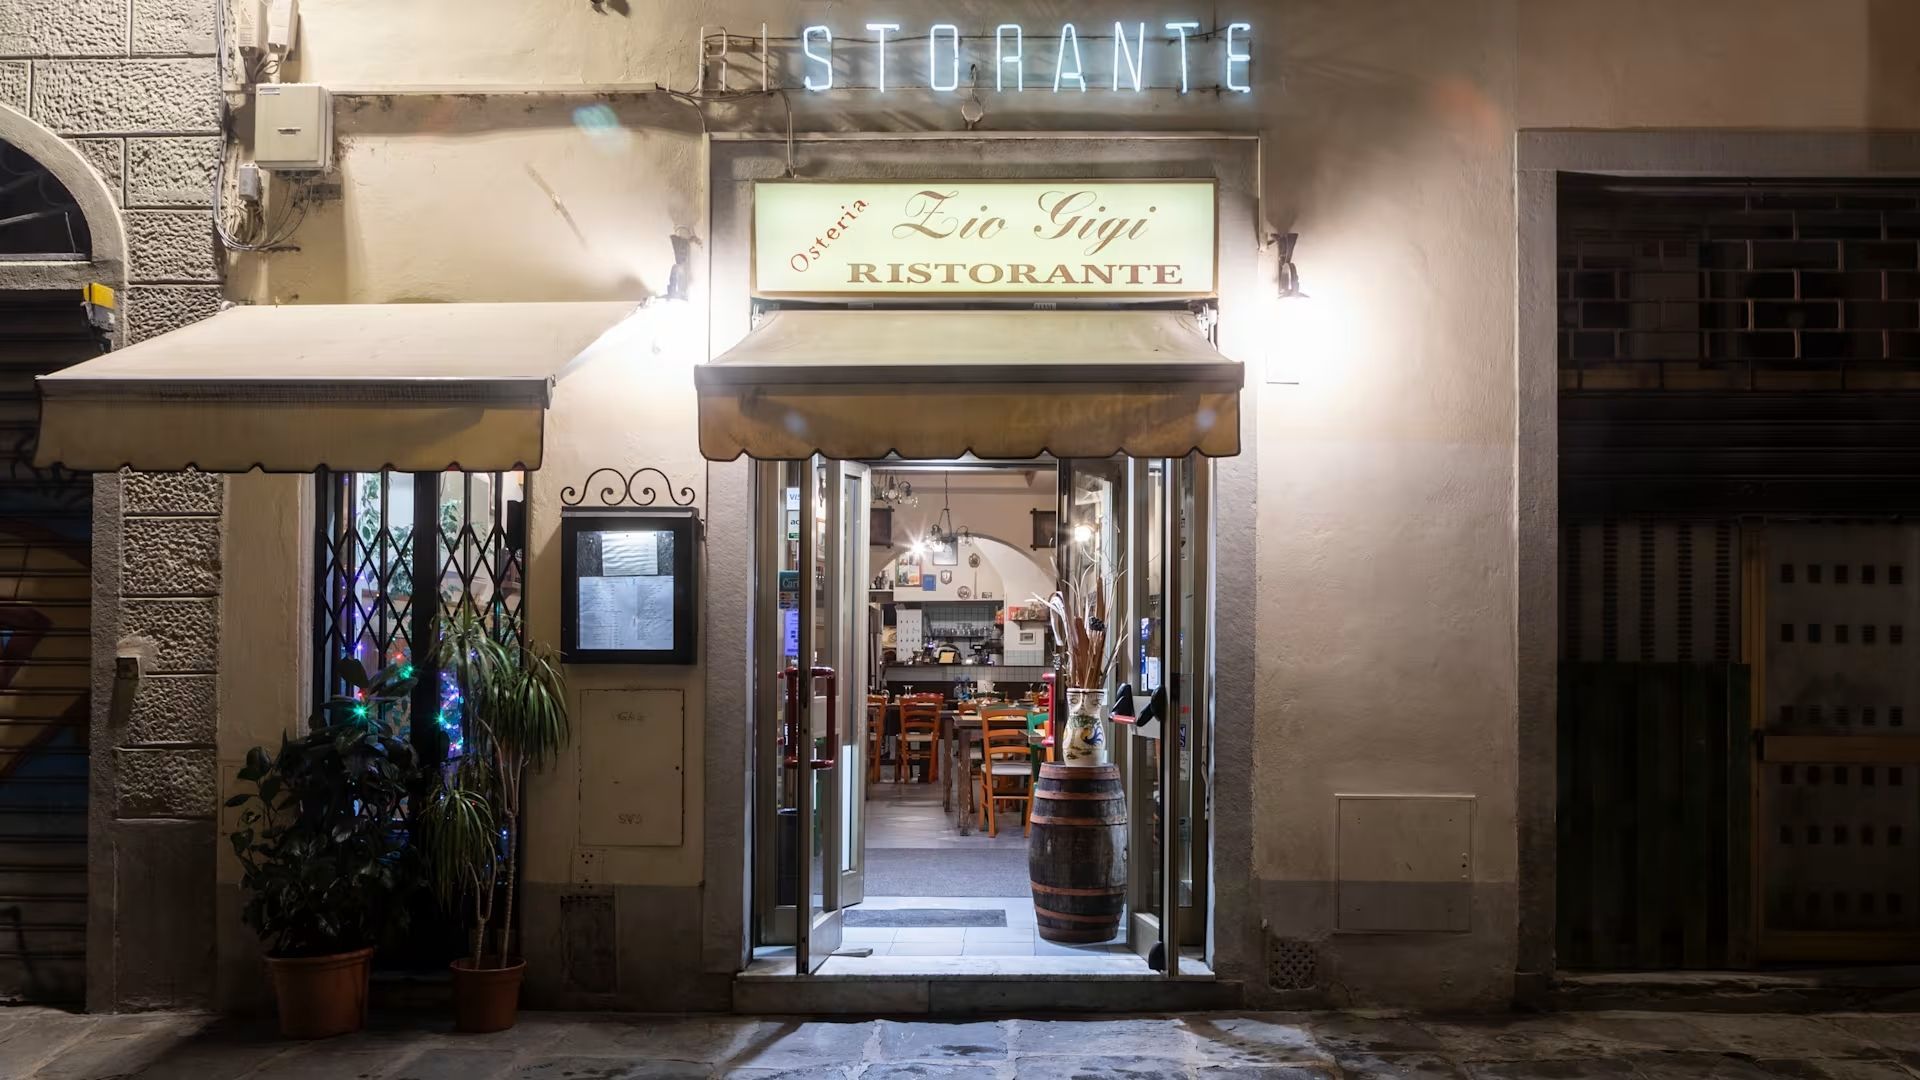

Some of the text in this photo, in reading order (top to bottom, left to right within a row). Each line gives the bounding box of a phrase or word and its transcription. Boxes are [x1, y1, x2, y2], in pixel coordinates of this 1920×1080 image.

[698, 22, 1252, 93] RISTORANTE
[790, 197, 870, 273] Osteria
[891, 190, 1157, 256] Zio Gigi
[847, 262, 1183, 285] RISTORANTE
